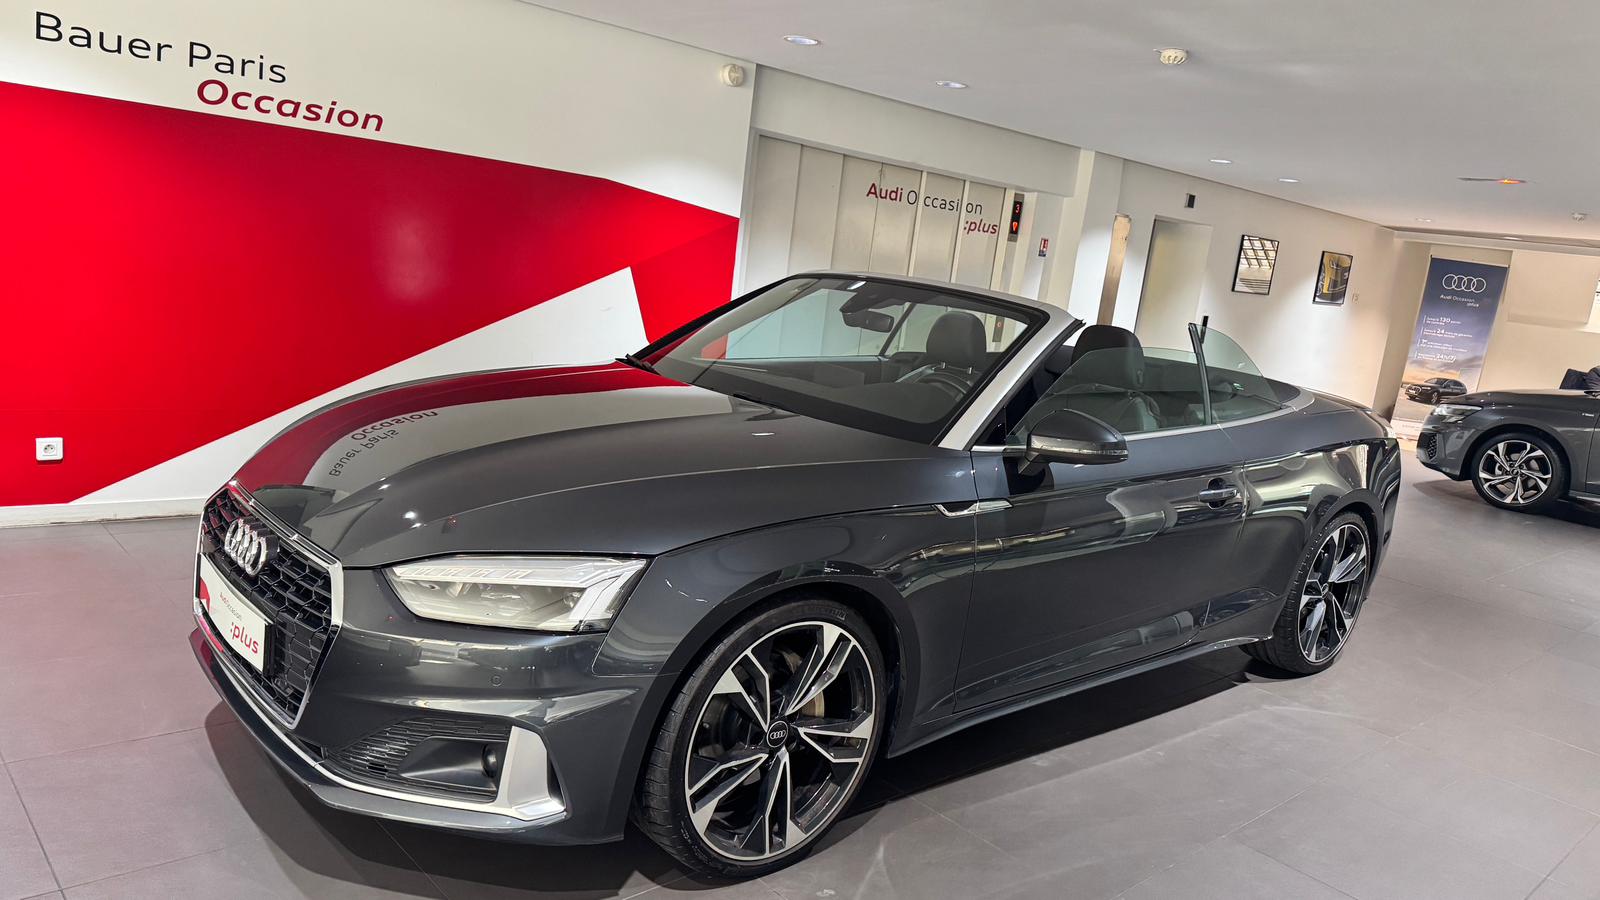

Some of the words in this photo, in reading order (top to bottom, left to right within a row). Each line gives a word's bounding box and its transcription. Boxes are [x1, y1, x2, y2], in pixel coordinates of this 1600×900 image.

[35, 11, 173, 62] Bauer
[188, 41, 287, 84] Paris
[197, 79, 384, 132] Occasion
[866, 182, 903, 202] Audi
[963, 219, 998, 235] :plus
[230, 621, 259, 654] :plus
